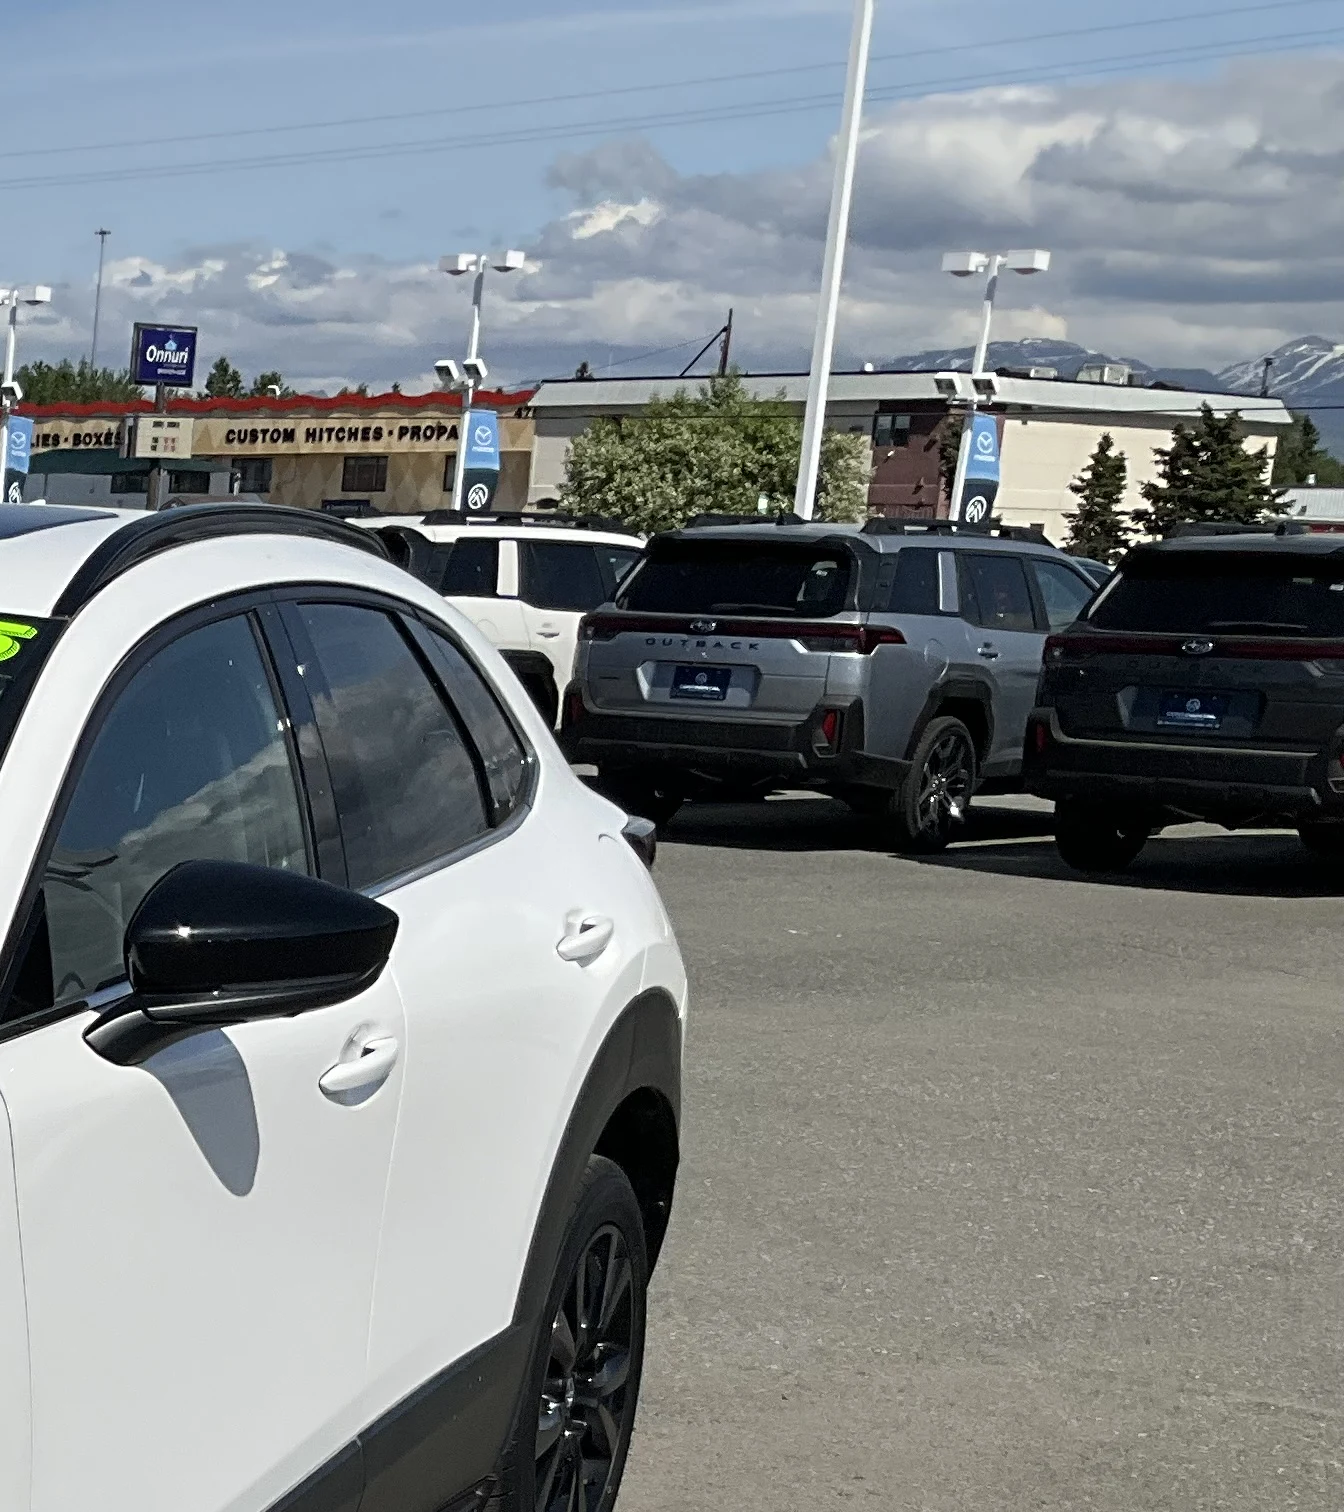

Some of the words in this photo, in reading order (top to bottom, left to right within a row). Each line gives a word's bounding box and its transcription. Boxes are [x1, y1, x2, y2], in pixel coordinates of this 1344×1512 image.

[146, 345, 188, 363] Onnuri
[225, 428, 295, 444] CUSTOM
[305, 426, 382, 442] HITCHES
[398, 424, 459, 441] PROPA
[645, 638, 760, 650] OUTBACK
